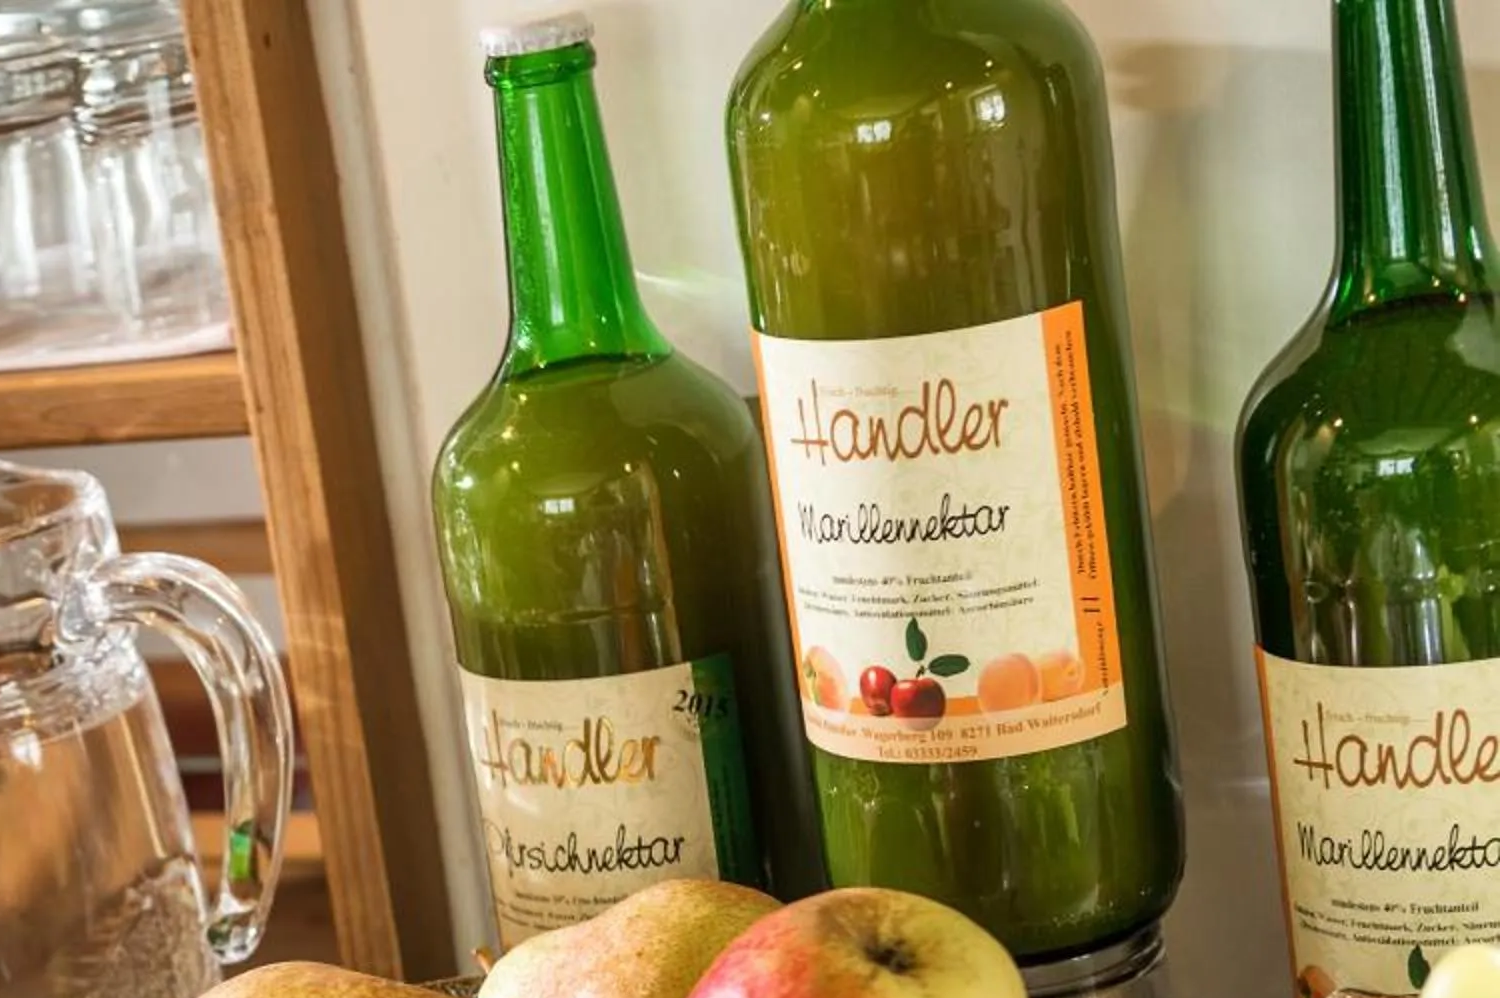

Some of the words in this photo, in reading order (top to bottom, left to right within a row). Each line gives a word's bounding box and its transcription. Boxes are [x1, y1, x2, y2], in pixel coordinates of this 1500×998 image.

[790, 378, 1009, 467] Handler
[797, 493, 1011, 545] Marillennektar
[480, 709, 661, 789] Handler
[996, 721, 1024, 736] Bad
